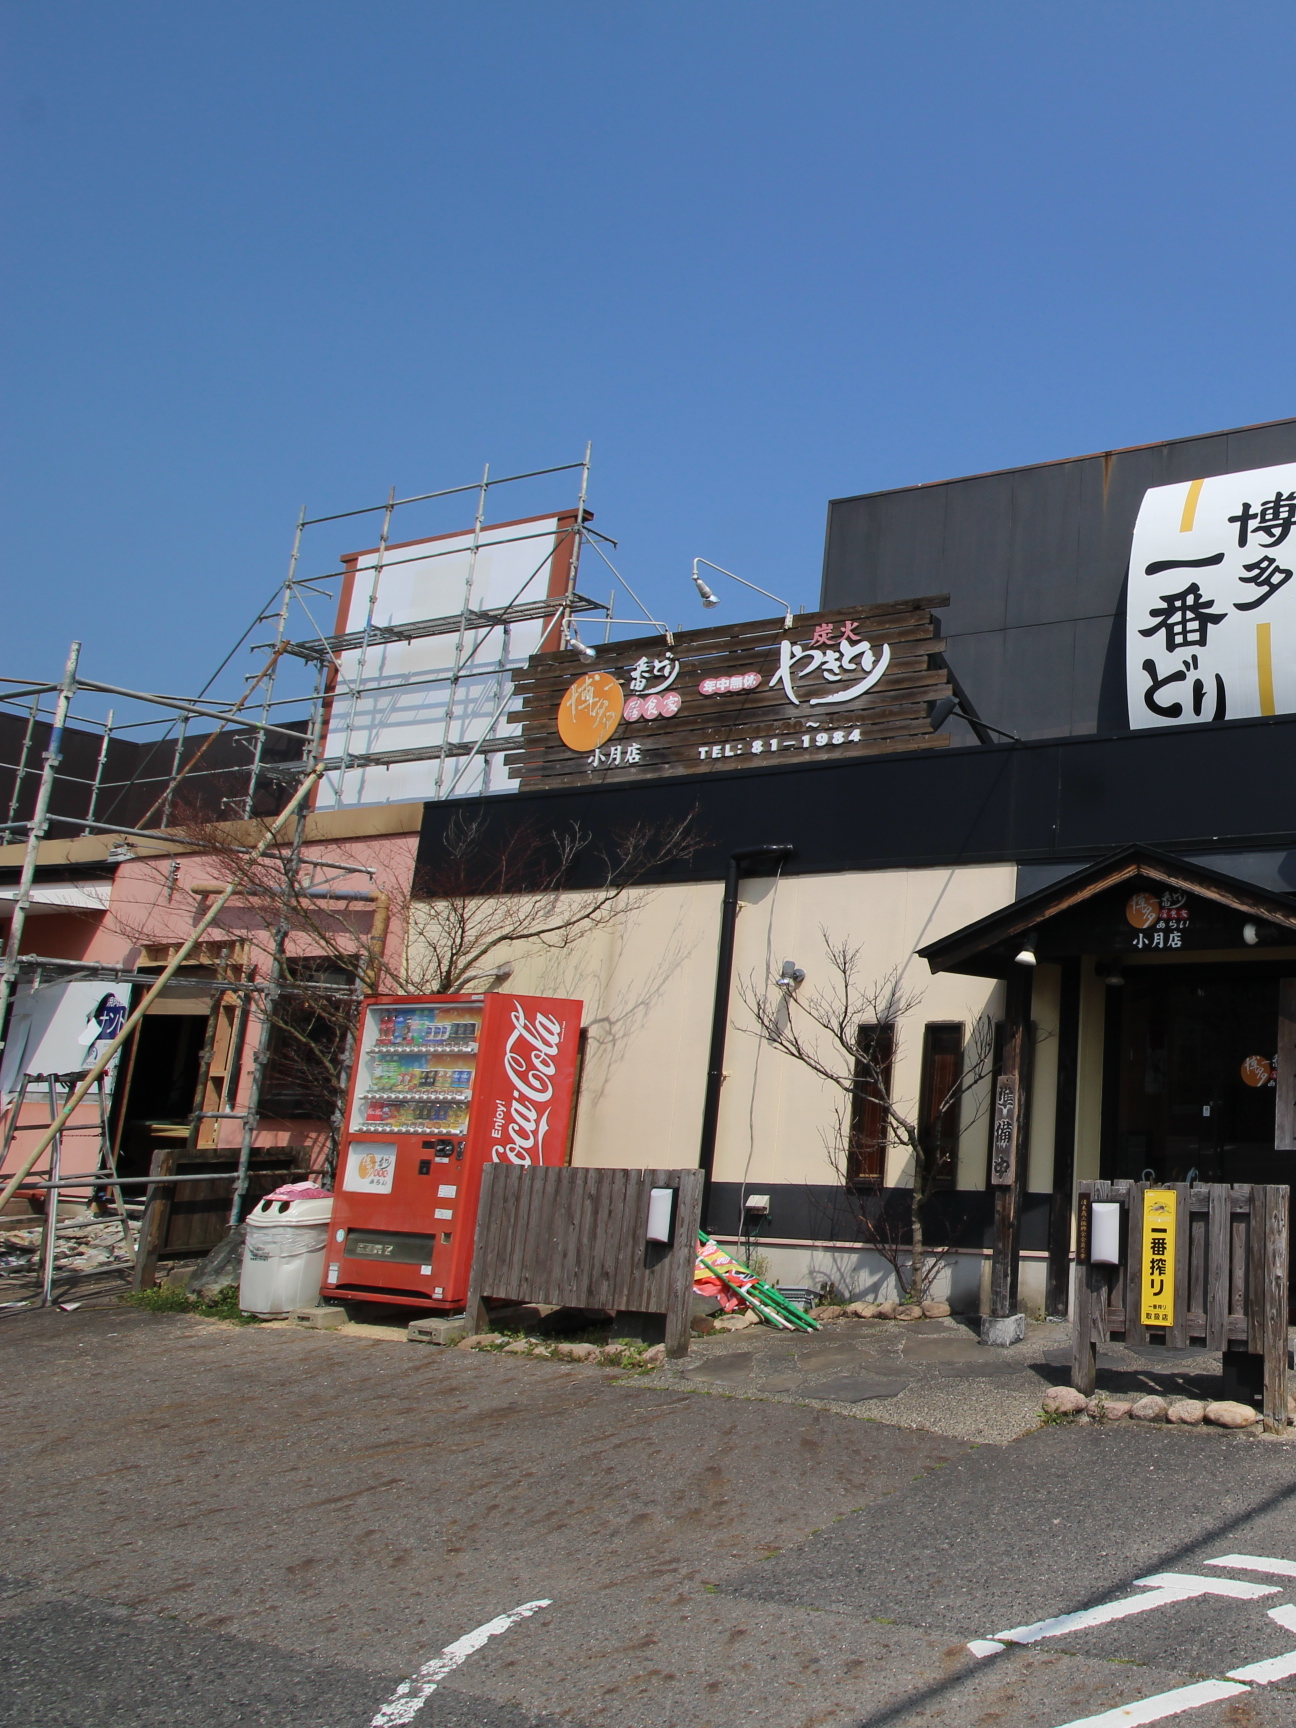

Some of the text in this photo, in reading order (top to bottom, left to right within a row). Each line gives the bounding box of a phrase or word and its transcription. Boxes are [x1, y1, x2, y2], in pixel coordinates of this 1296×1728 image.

[809, 621, 862, 647] 炭火
[1137, 551, 1229, 722] 一番どり
[703, 675, 757, 693] 年中無休
[769, 639, 891, 706] やきとり
[624, 694, 680, 719] 居食家
[588, 743, 642, 768] 小月店
[699, 729, 862, 760] TEL: 81-1984
[1156, 920, 1189, 929] あらい
[1133, 931, 1182, 949] 小月店
[491, 1099, 507, 1139] Enjoy!
[993, 1086, 1014, 1181] 準備中
[1149, 1227, 1168, 1297] 一番搾り
[1145, 1312, 1169, 1321] 取扱店
